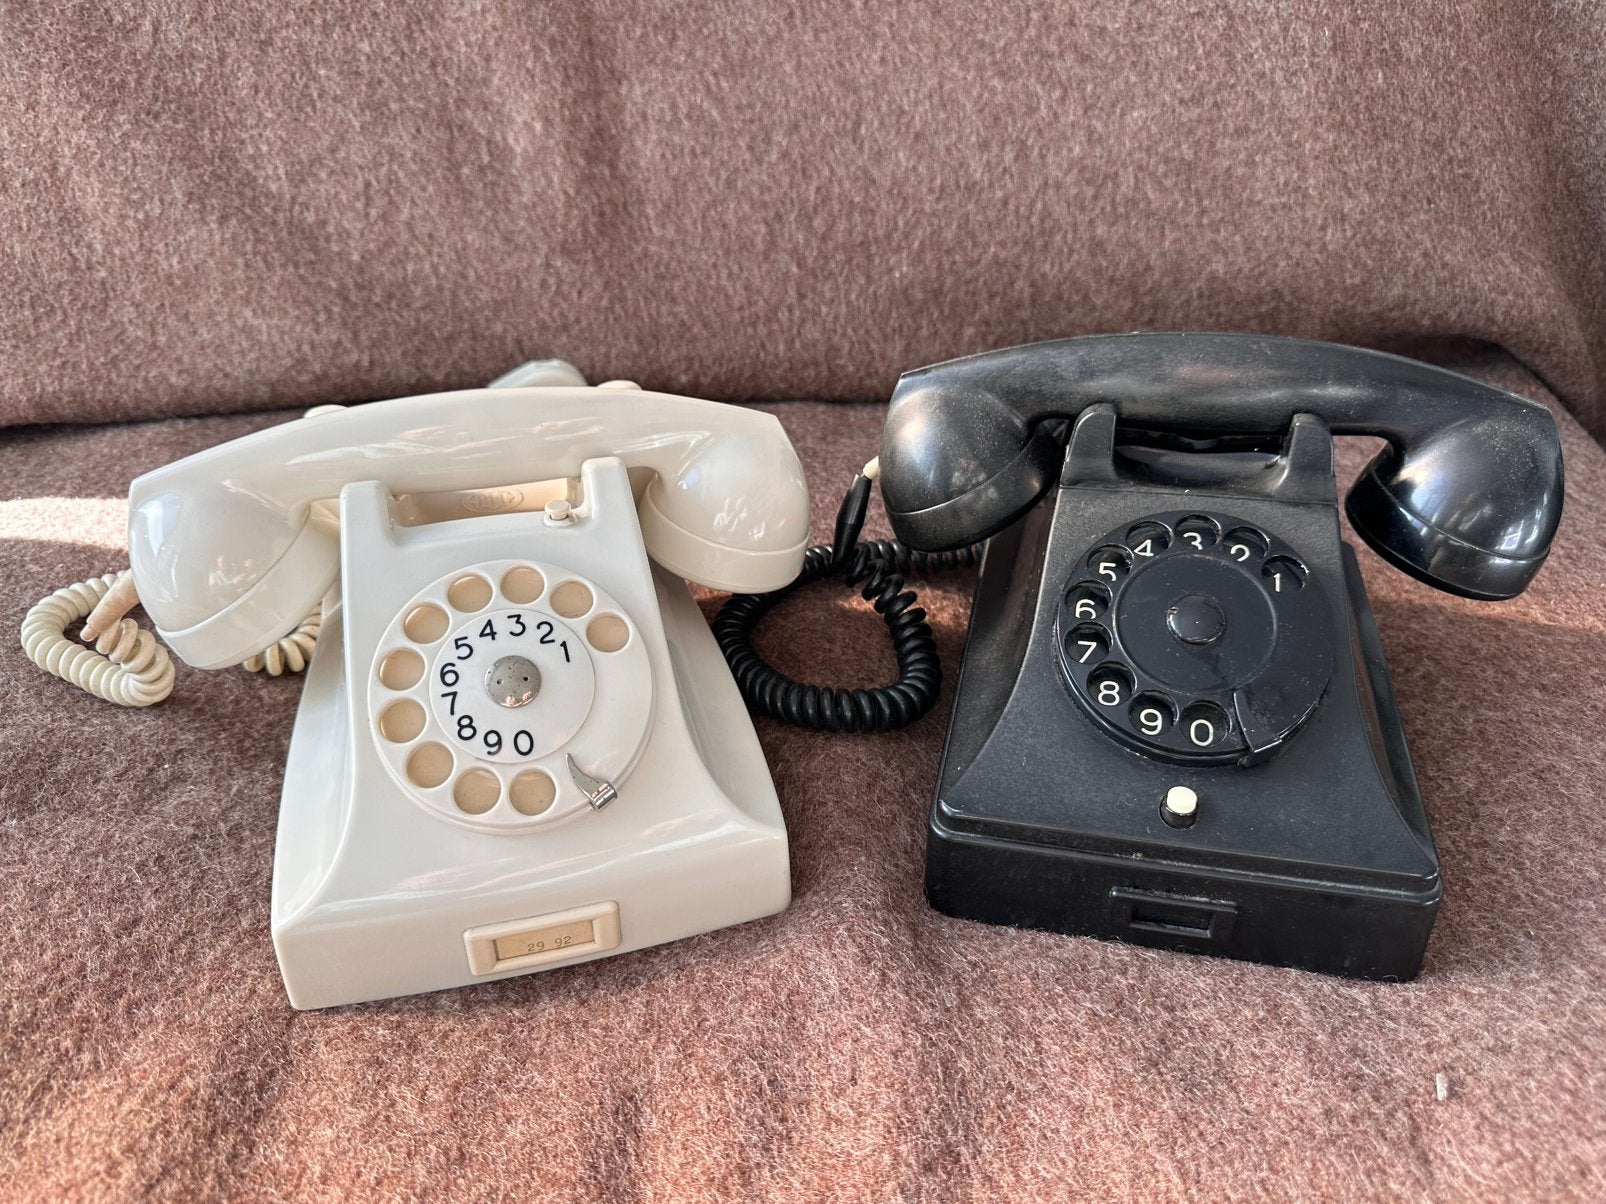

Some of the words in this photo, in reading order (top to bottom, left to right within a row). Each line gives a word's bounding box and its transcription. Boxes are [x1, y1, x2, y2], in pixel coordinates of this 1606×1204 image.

[1133, 539, 1154, 557] 4
[1183, 532, 1203, 551] 3
[1098, 562, 1117, 582] 5
[1273, 572, 1281, 593] 1
[1075, 598, 1097, 620] 6
[478, 618, 498, 641] 4
[507, 613, 527, 637] 3
[536, 620, 556, 645] 2
[454, 636, 474, 661] 5
[560, 640, 571, 663] 1
[1077, 640, 1097, 664] 7
[439, 662, 460, 688] 6
[440, 690, 458, 716] 7
[1097, 680, 1120, 706] 8
[456, 714, 477, 741] 8
[1139, 708, 1163, 736] 9
[1190, 719, 1214, 747] 0
[483, 729, 503, 756] 9
[513, 729, 534, 757] 0
[527, 941, 545, 952] 29
[554, 935, 572, 948] 92
